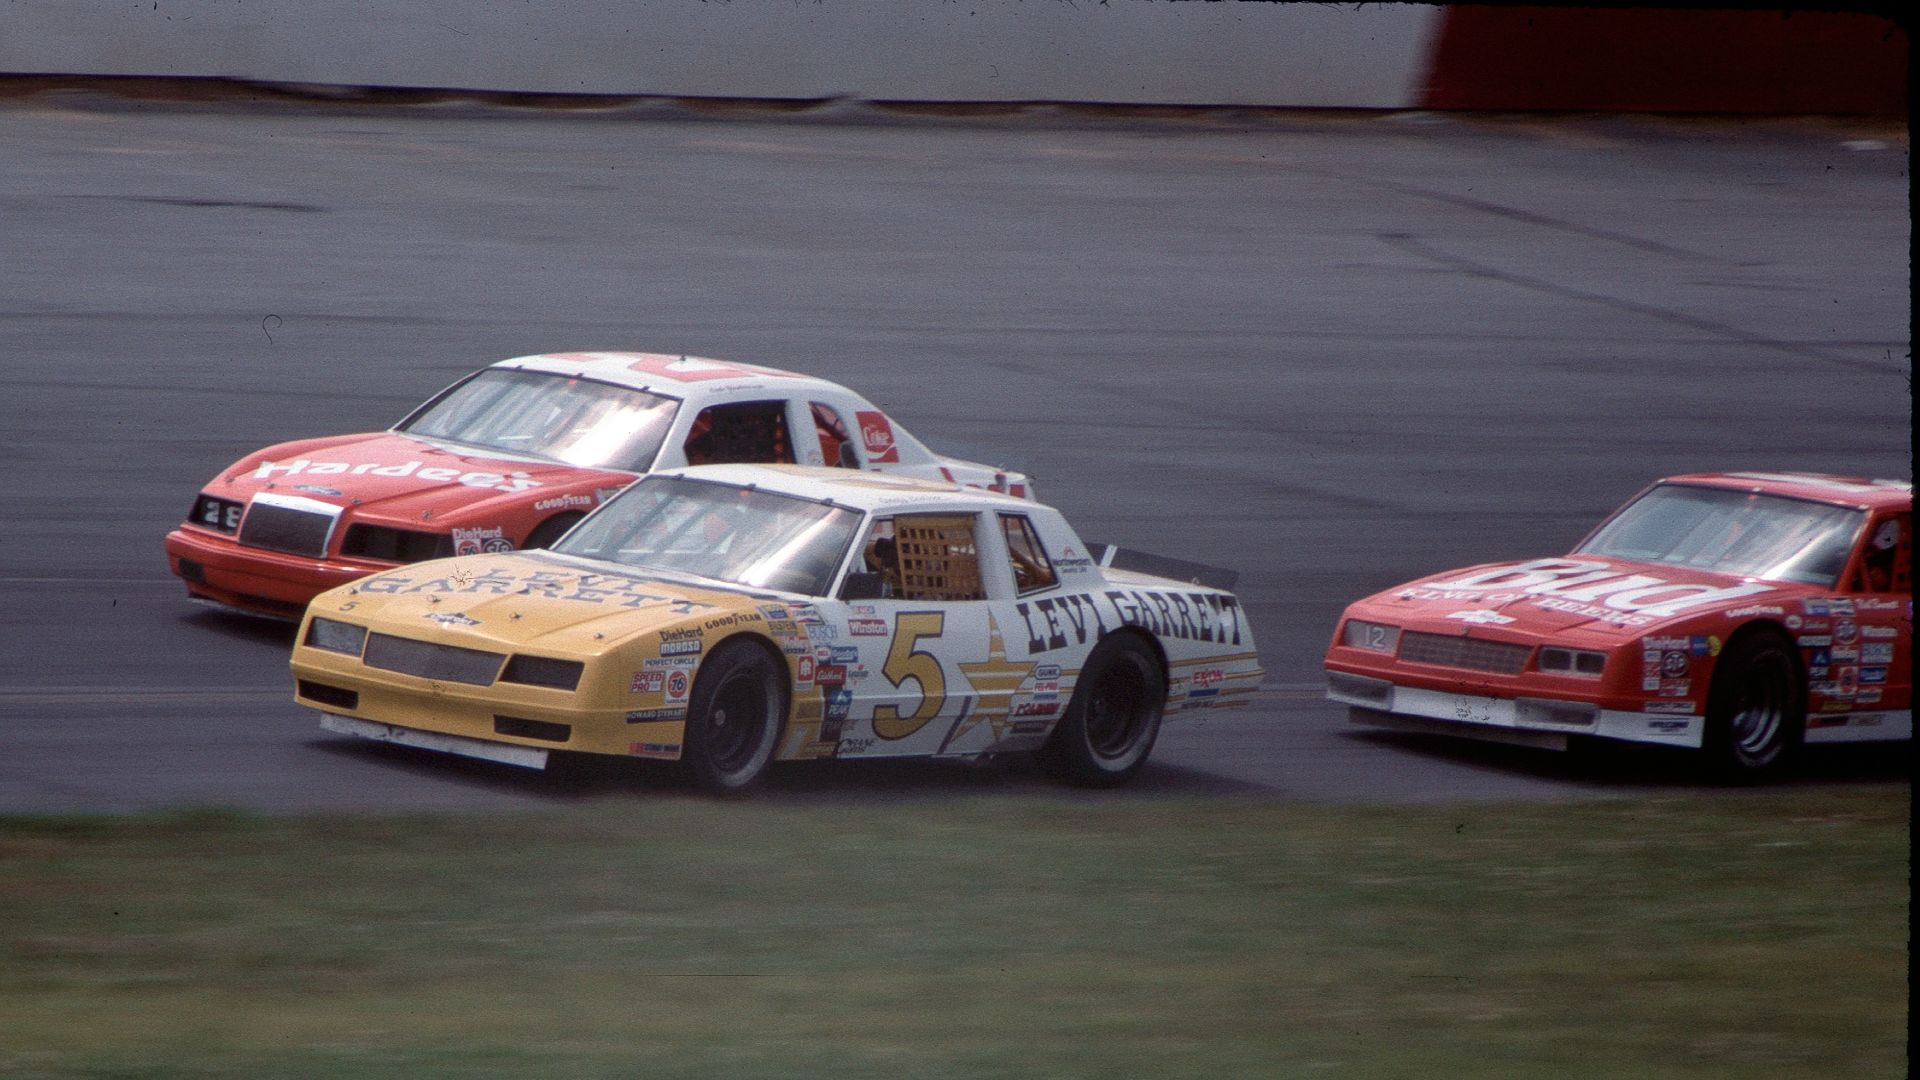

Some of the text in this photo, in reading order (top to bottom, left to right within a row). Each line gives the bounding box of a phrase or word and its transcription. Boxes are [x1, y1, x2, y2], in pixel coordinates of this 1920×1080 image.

[862, 426, 890, 447] Coke
[253, 459, 543, 493] Hardee's
[534, 493, 592, 511] GOODYEAR
[452, 526, 502, 539] DieHard
[359, 576, 720, 614] GARRETT
[1422, 557, 1776, 617] Bud
[338, 601, 361, 612] 5
[705, 612, 762, 630] GOODYEAR
[850, 621, 887, 634] Winston
[1016, 590, 1241, 655] LEVI GARRETT
[659, 626, 704, 641] DieHard
[1364, 625, 1385, 649] 12
[632, 672, 662, 682] SPEED
[670, 678, 685, 691] 76
[871, 610, 948, 741] 5
[630, 682, 650, 691] PRO
